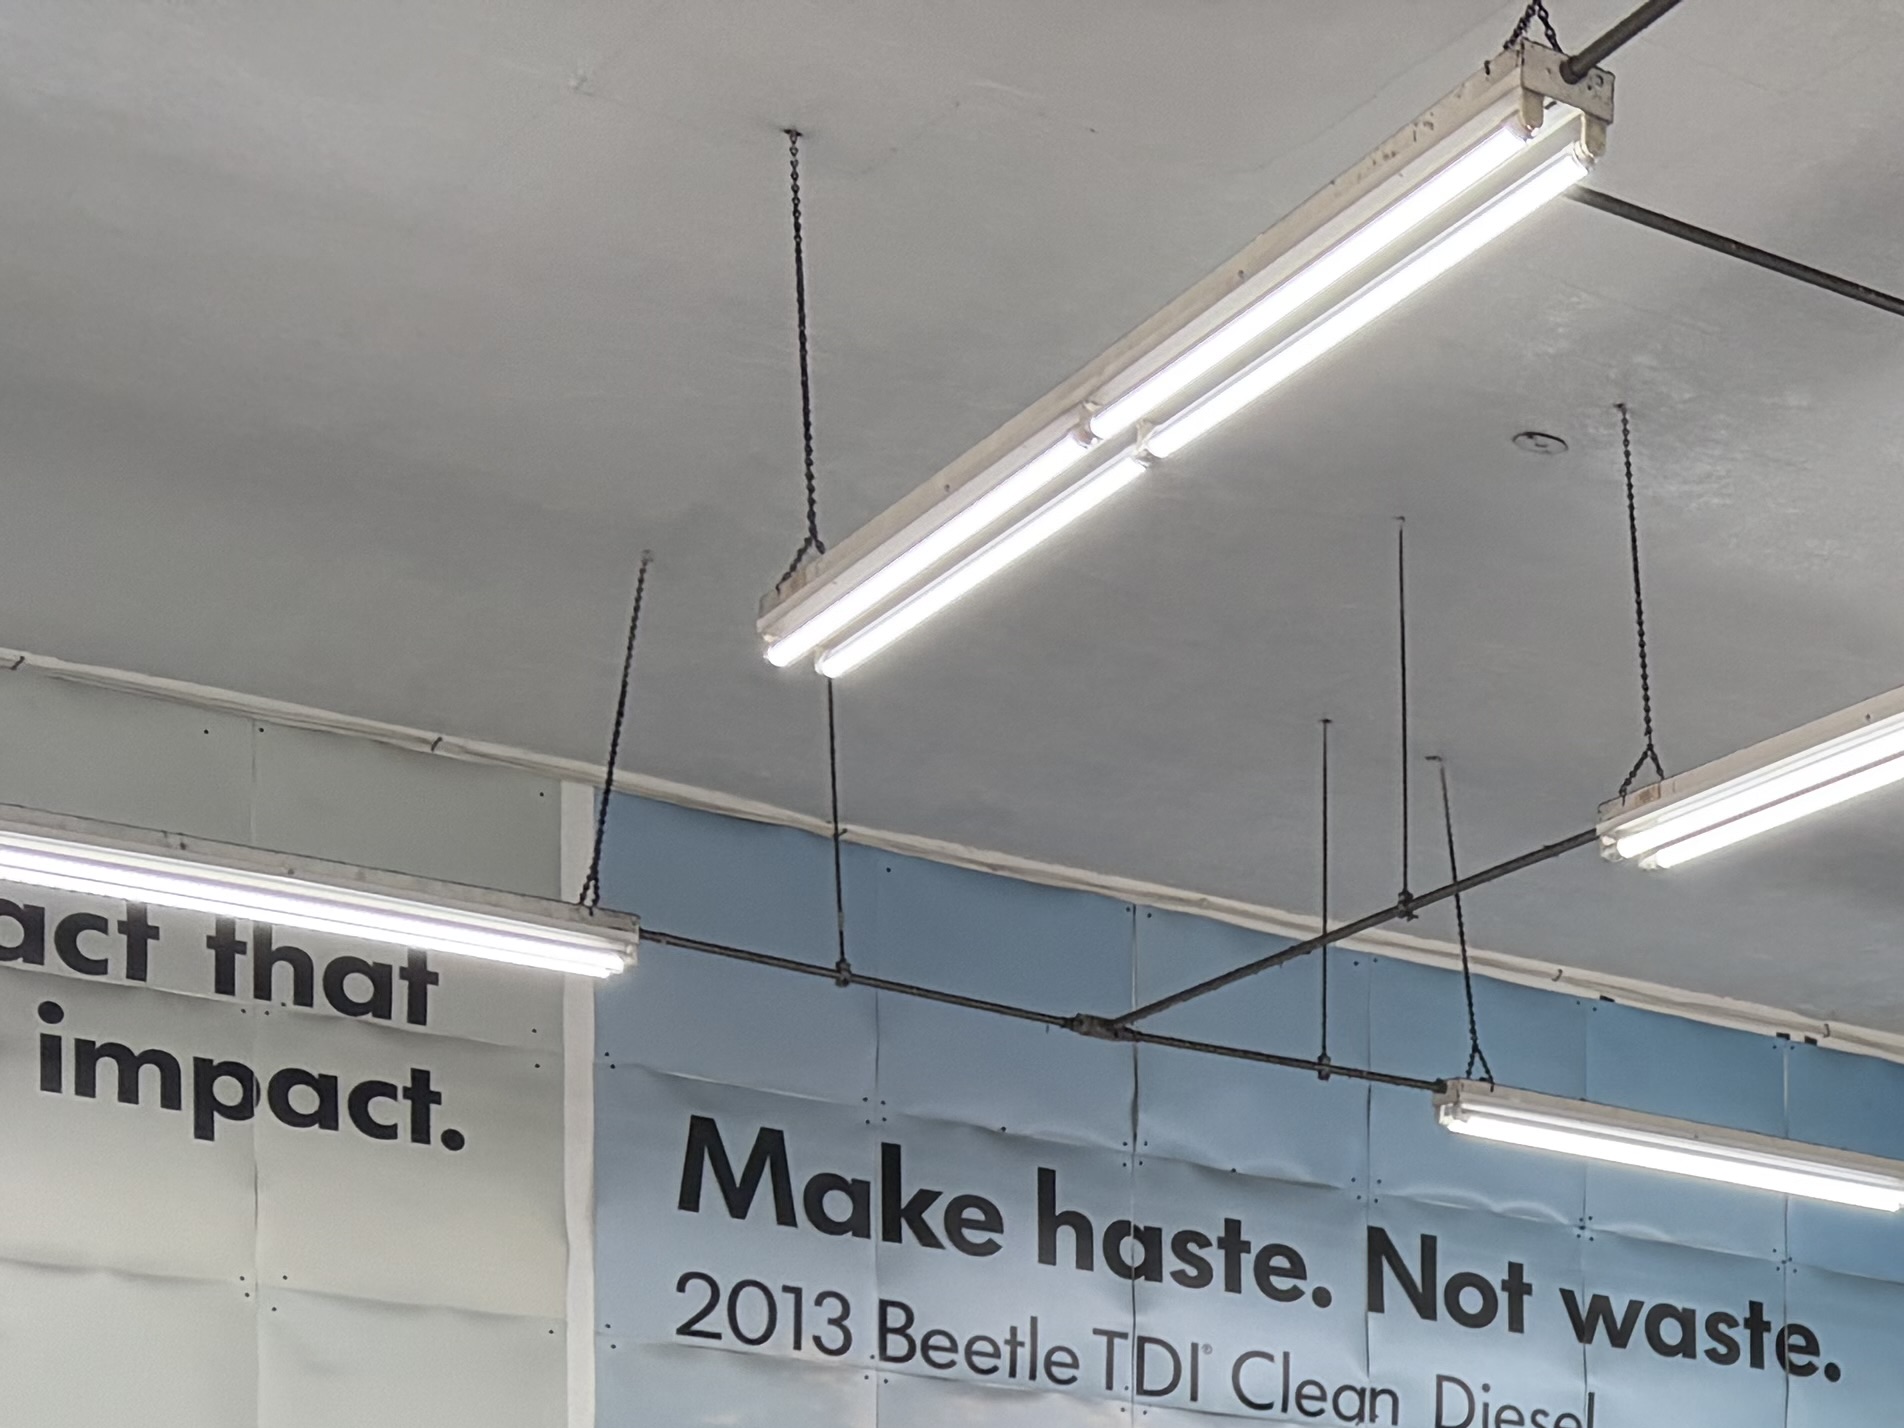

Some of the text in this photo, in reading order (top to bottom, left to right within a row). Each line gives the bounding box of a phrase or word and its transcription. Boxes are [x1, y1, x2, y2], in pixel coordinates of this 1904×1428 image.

[207, 916, 439, 1026] that
[38, 1001, 466, 1152] impact.
[677, 1114, 1842, 1383] Make haste. Not waste.
[675, 1271, 853, 1357] 2013
[877, 1302, 1080, 1386] Beetle
[1232, 1350, 1401, 1427] Clean
